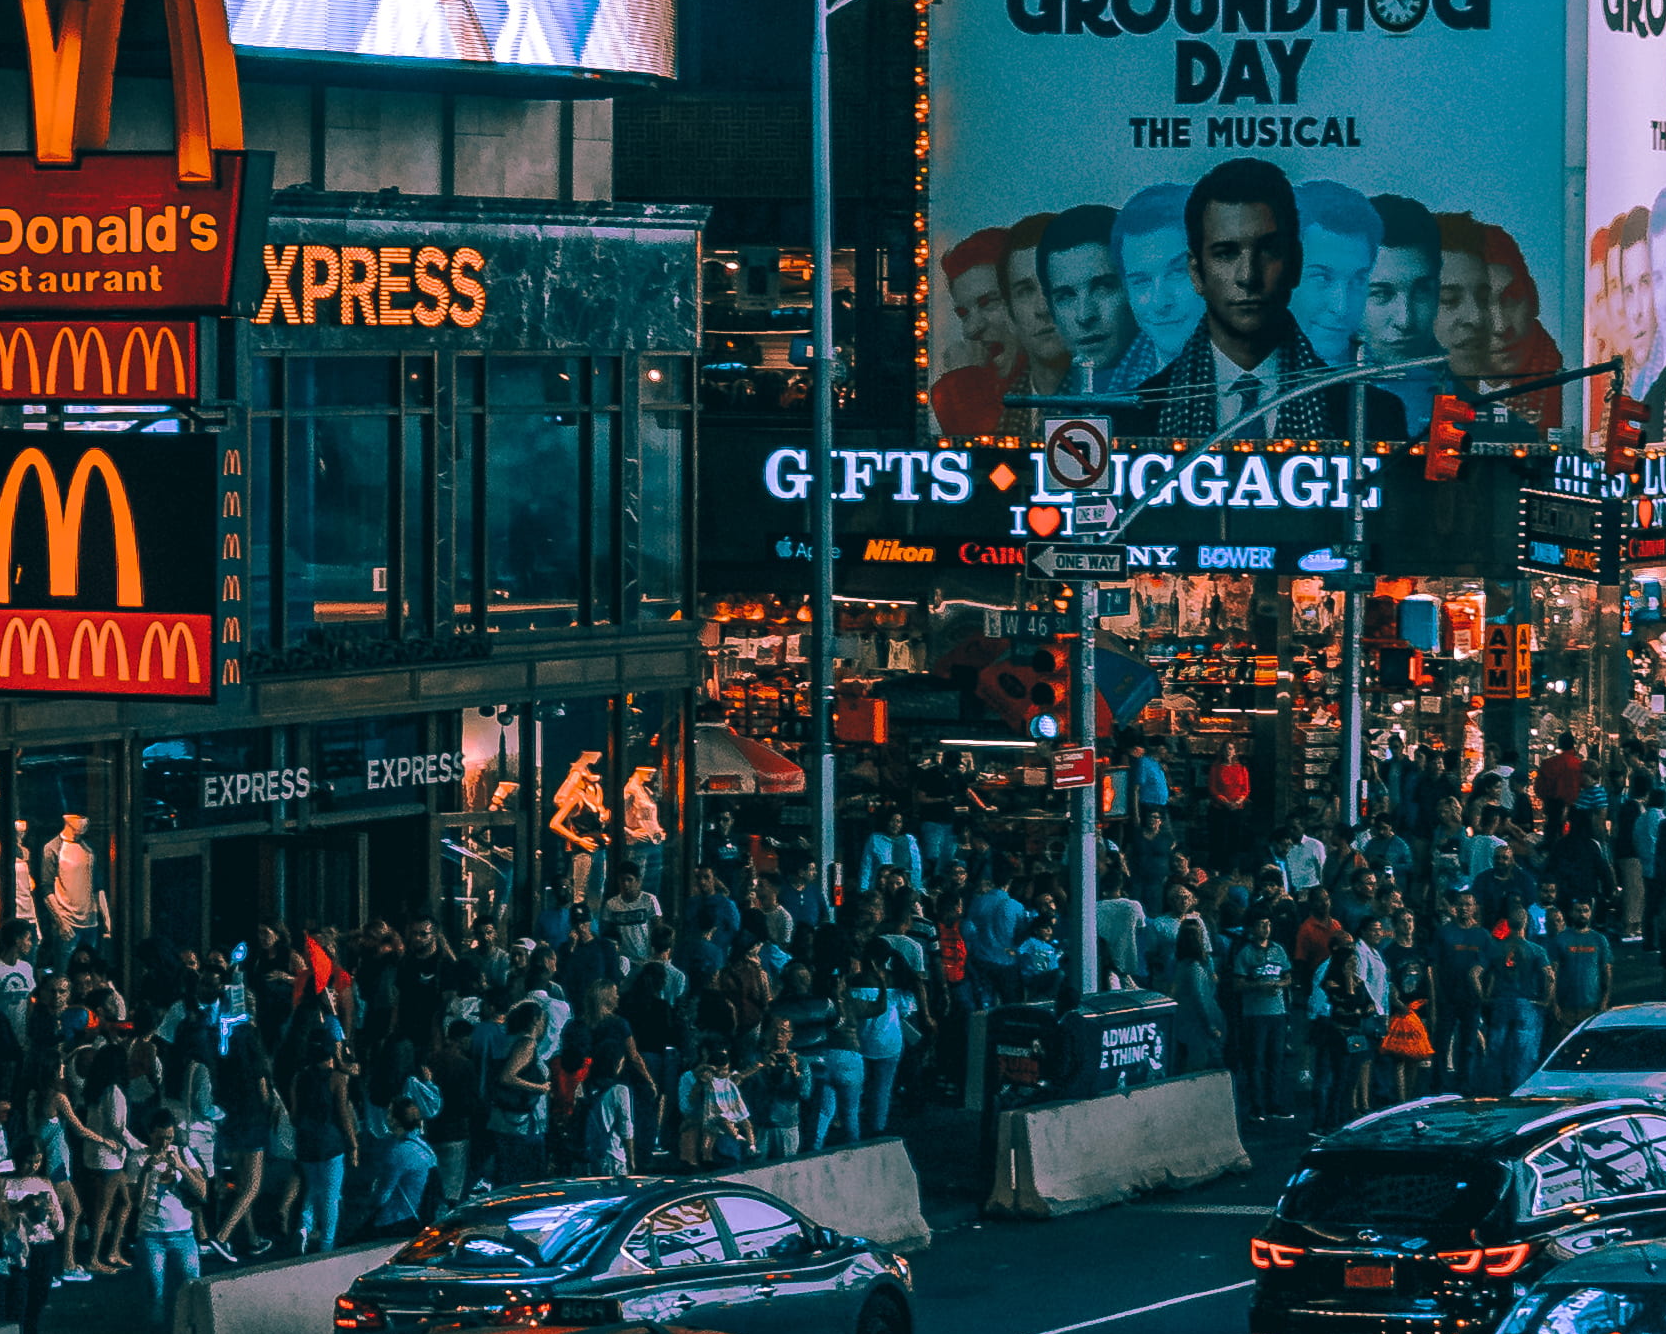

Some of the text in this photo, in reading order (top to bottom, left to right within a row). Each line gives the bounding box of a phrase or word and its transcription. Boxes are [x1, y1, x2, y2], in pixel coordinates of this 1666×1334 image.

[1173, 38, 1315, 107] DAY
[1129, 114, 1361, 150] THE MUSICAL
[256, 244, 486, 327] XPRESS
[764, 447, 972, 503] GFTS
[863, 538, 935, 563] Nikon
[1198, 545, 1276, 569] BOWER
[1055, 554, 1118, 570] ONE WAY
[1004, 617, 1048, 637] W 46
[1488, 629, 1511, 694] ATM
[1517, 627, 1529, 696] ATM
[203, 751, 466, 809] EXPRESS EXPRESS
